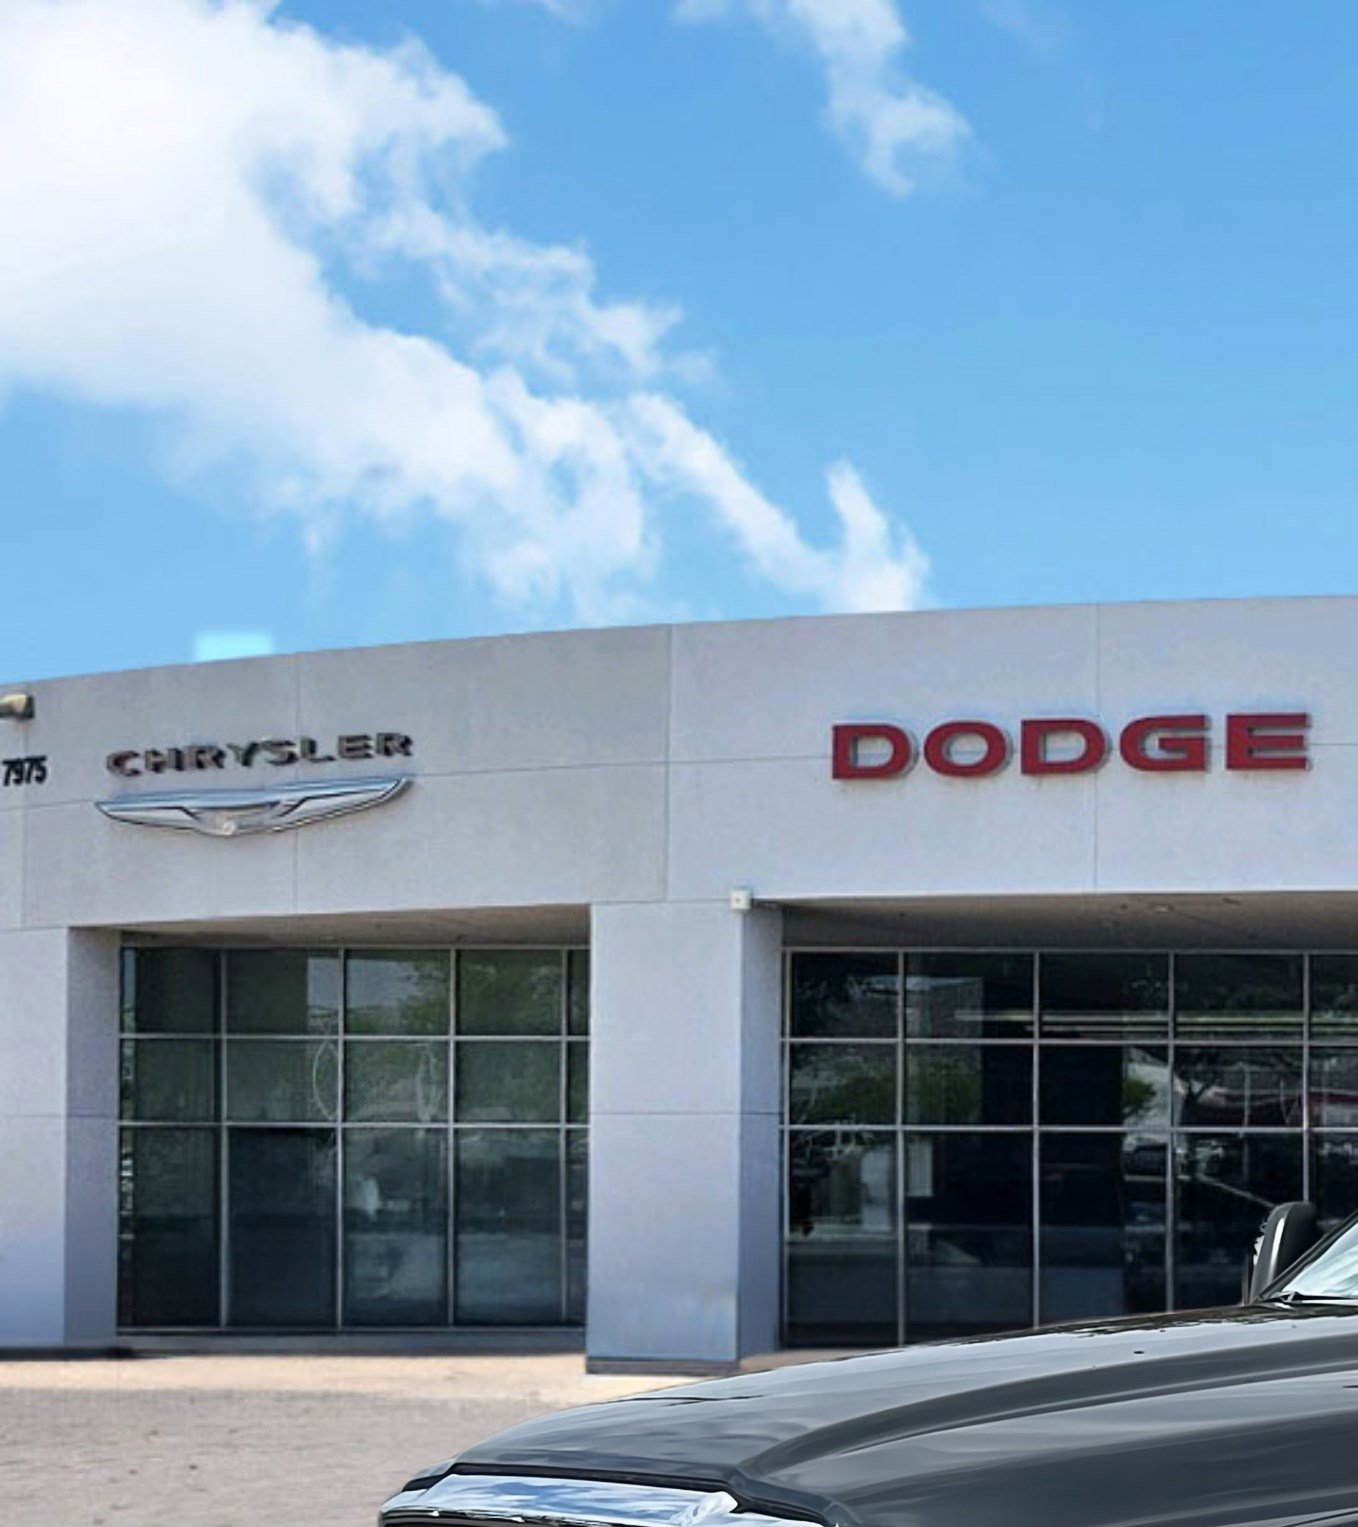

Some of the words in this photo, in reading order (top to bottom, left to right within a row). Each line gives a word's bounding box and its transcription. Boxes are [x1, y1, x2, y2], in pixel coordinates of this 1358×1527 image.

[105, 731, 414, 778] CHRYSLER
[831, 712, 1312, 781] DODGE
[1, 755, 48, 787] 7975
